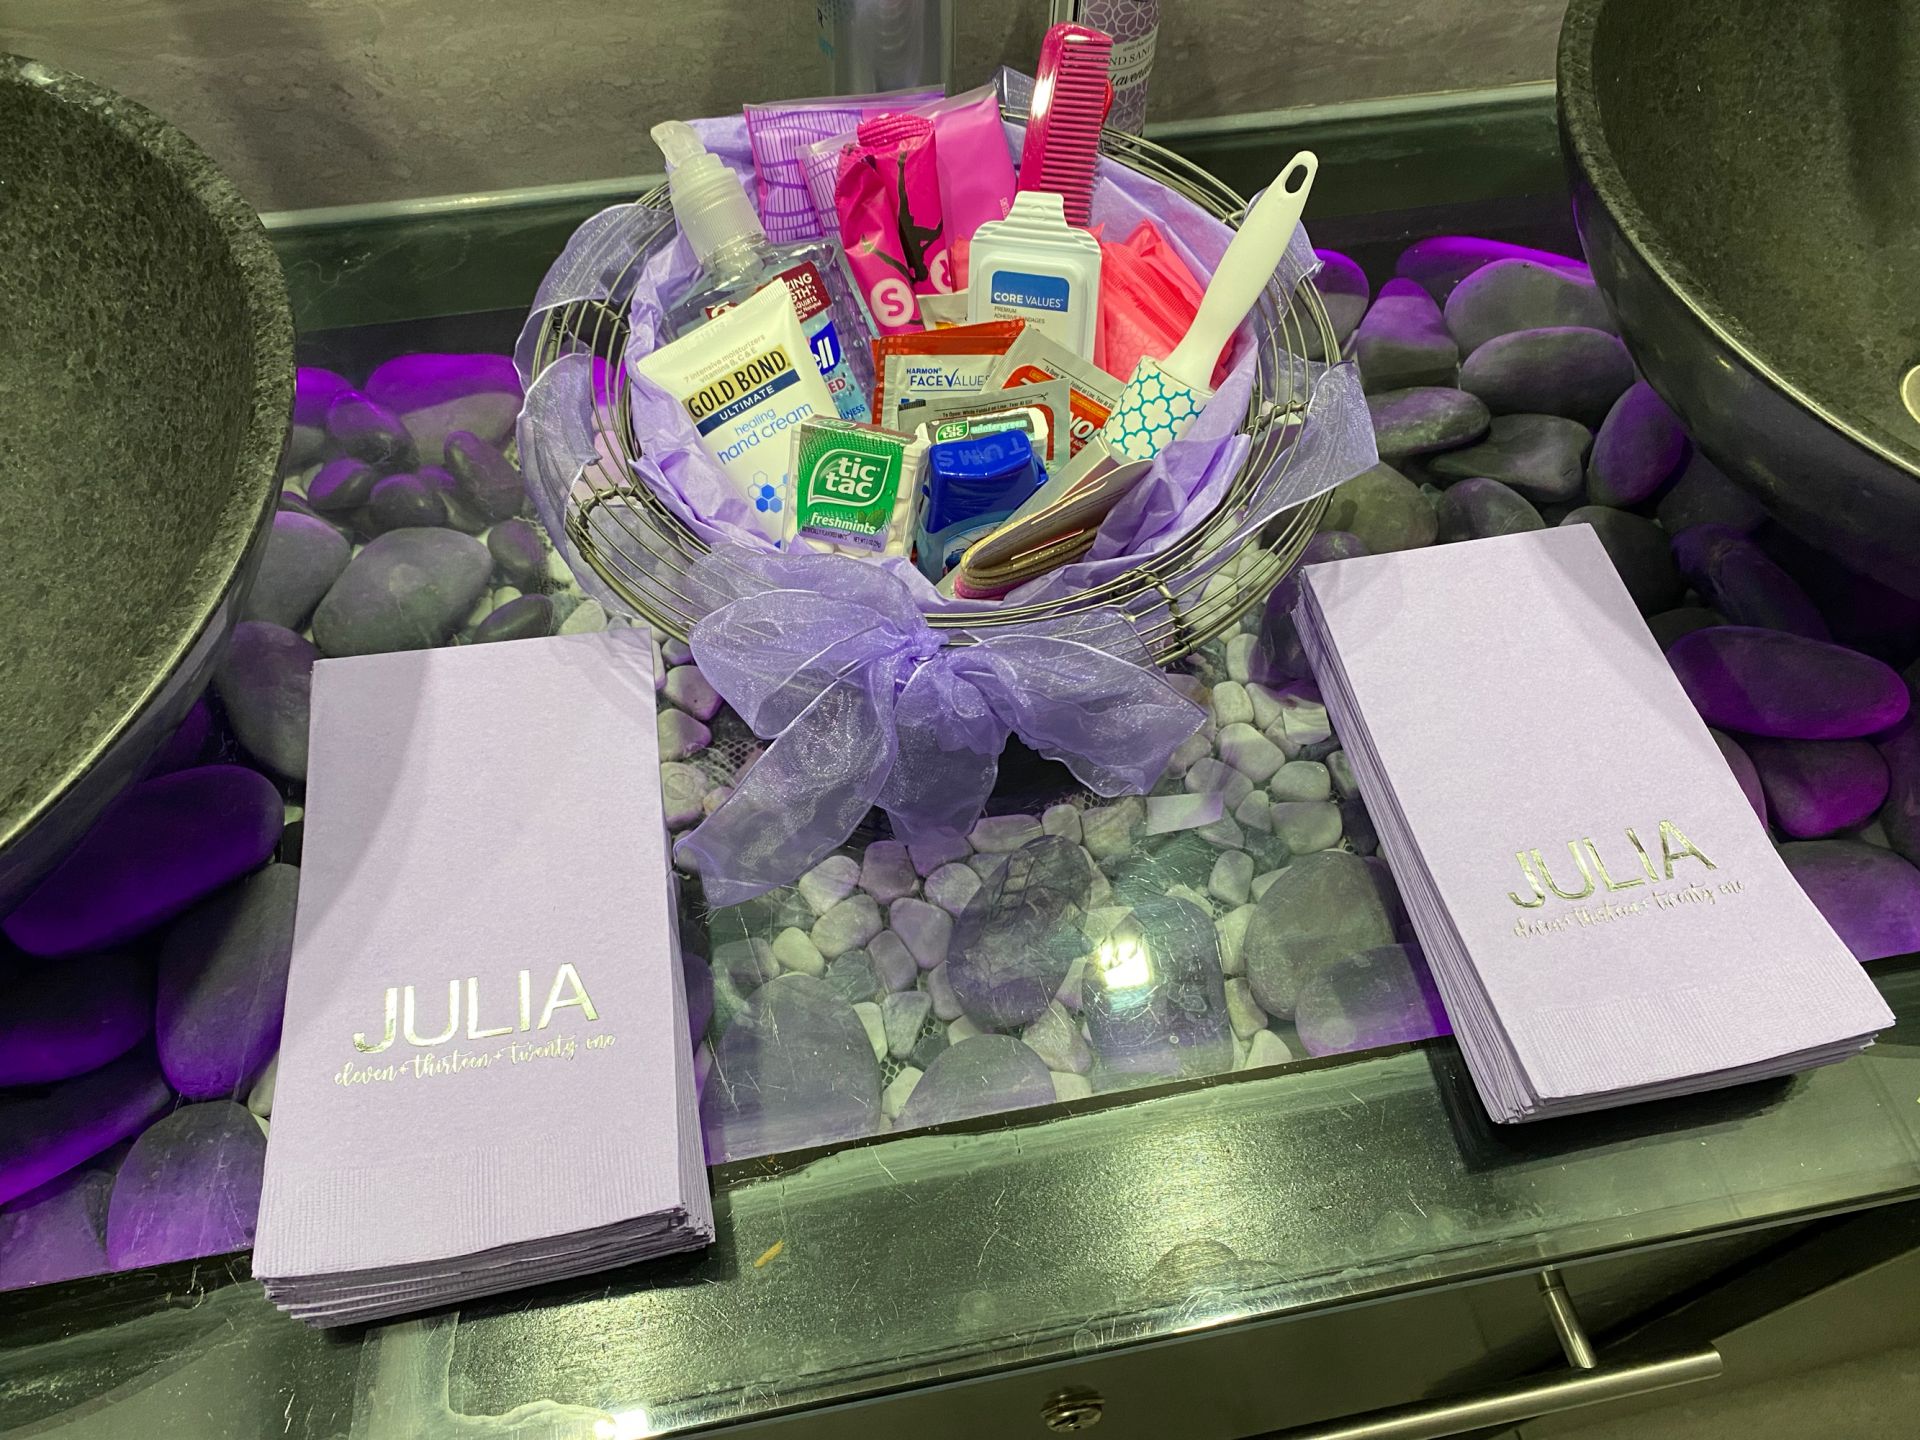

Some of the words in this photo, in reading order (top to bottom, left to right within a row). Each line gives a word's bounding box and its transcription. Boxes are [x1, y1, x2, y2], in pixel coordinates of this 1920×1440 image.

[793, 296, 818, 311] QUIRTS
[993, 291, 1024, 304] CORE
[687, 380, 736, 419] GOLD
[734, 350, 787, 393] BOND
[719, 384, 776, 421] ULTIMATE
[717, 429, 761, 465] hand
[761, 403, 815, 438] cream
[734, 408, 778, 436] healing
[970, 419, 1028, 434] wintergreen
[936, 437, 1027, 468] TUMS
[838, 457, 877, 481] tic
[825, 471, 873, 498] tac
[810, 512, 877, 535] freshmints
[1507, 818, 1718, 908] JULIA
[352, 962, 599, 1054] JULIA
[501, 1034, 578, 1064] twenty
[586, 1032, 617, 1050] one
